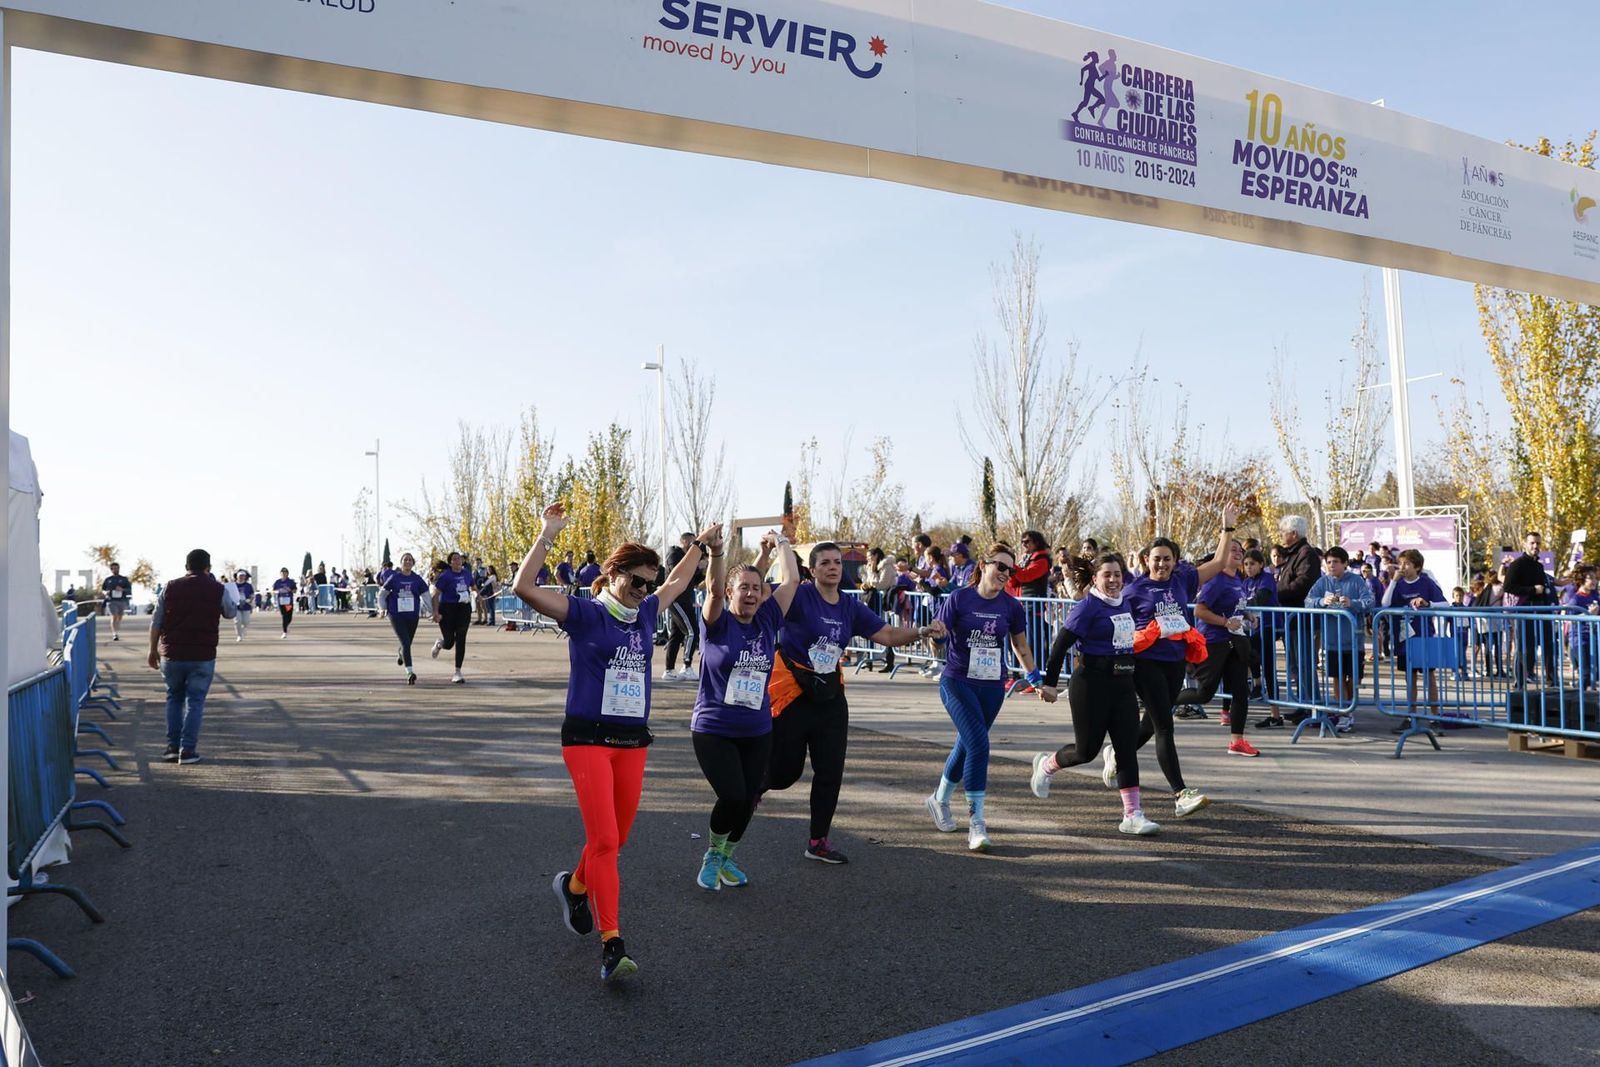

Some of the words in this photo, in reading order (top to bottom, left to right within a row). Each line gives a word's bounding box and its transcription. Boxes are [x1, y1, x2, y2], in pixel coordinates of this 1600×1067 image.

[658, 0, 882, 79] SERVIER
[643, 35, 714, 60] moved
[720, 46, 745, 70] by
[750, 56, 786, 74] you
[1121, 63, 1195, 102] CARRERA
[1144, 92, 1164, 117] DE
[1167, 97, 1196, 124] LAS
[1117, 109, 1197, 148] CIUDADES
[1245, 89, 1283, 146] 10
[1284, 122, 1347, 160] AÑOS
[1074, 126, 1105, 144] CONTRA
[1106, 133, 1116, 146] EL
[1117, 133, 1146, 152] CÁNCER
[1148, 141, 1158, 154] DE
[1076, 148, 1091, 168] 10
[1094, 150, 1125, 174] AÑOS
[1134, 160, 1196, 188] 2015-2024
[1232, 139, 1340, 186] MOVIDOS
[1340, 165, 1358, 179] POR
[1241, 169, 1370, 219] ESPERANZA
[1339, 178, 1350, 189] LA
[1461, 188, 1509, 209] ASOCIACIÓN
[1468, 205, 1502, 223] CÁNCER
[1460, 219, 1471, 232] DE
[1472, 221, 1512, 240] PÁNCREAS
[971, 629, 981, 640] 10
[614, 646, 628, 661] 10
[739, 650, 750, 662] 10
[613, 683, 641, 698] 1453
[736, 680, 762, 693] 1128
